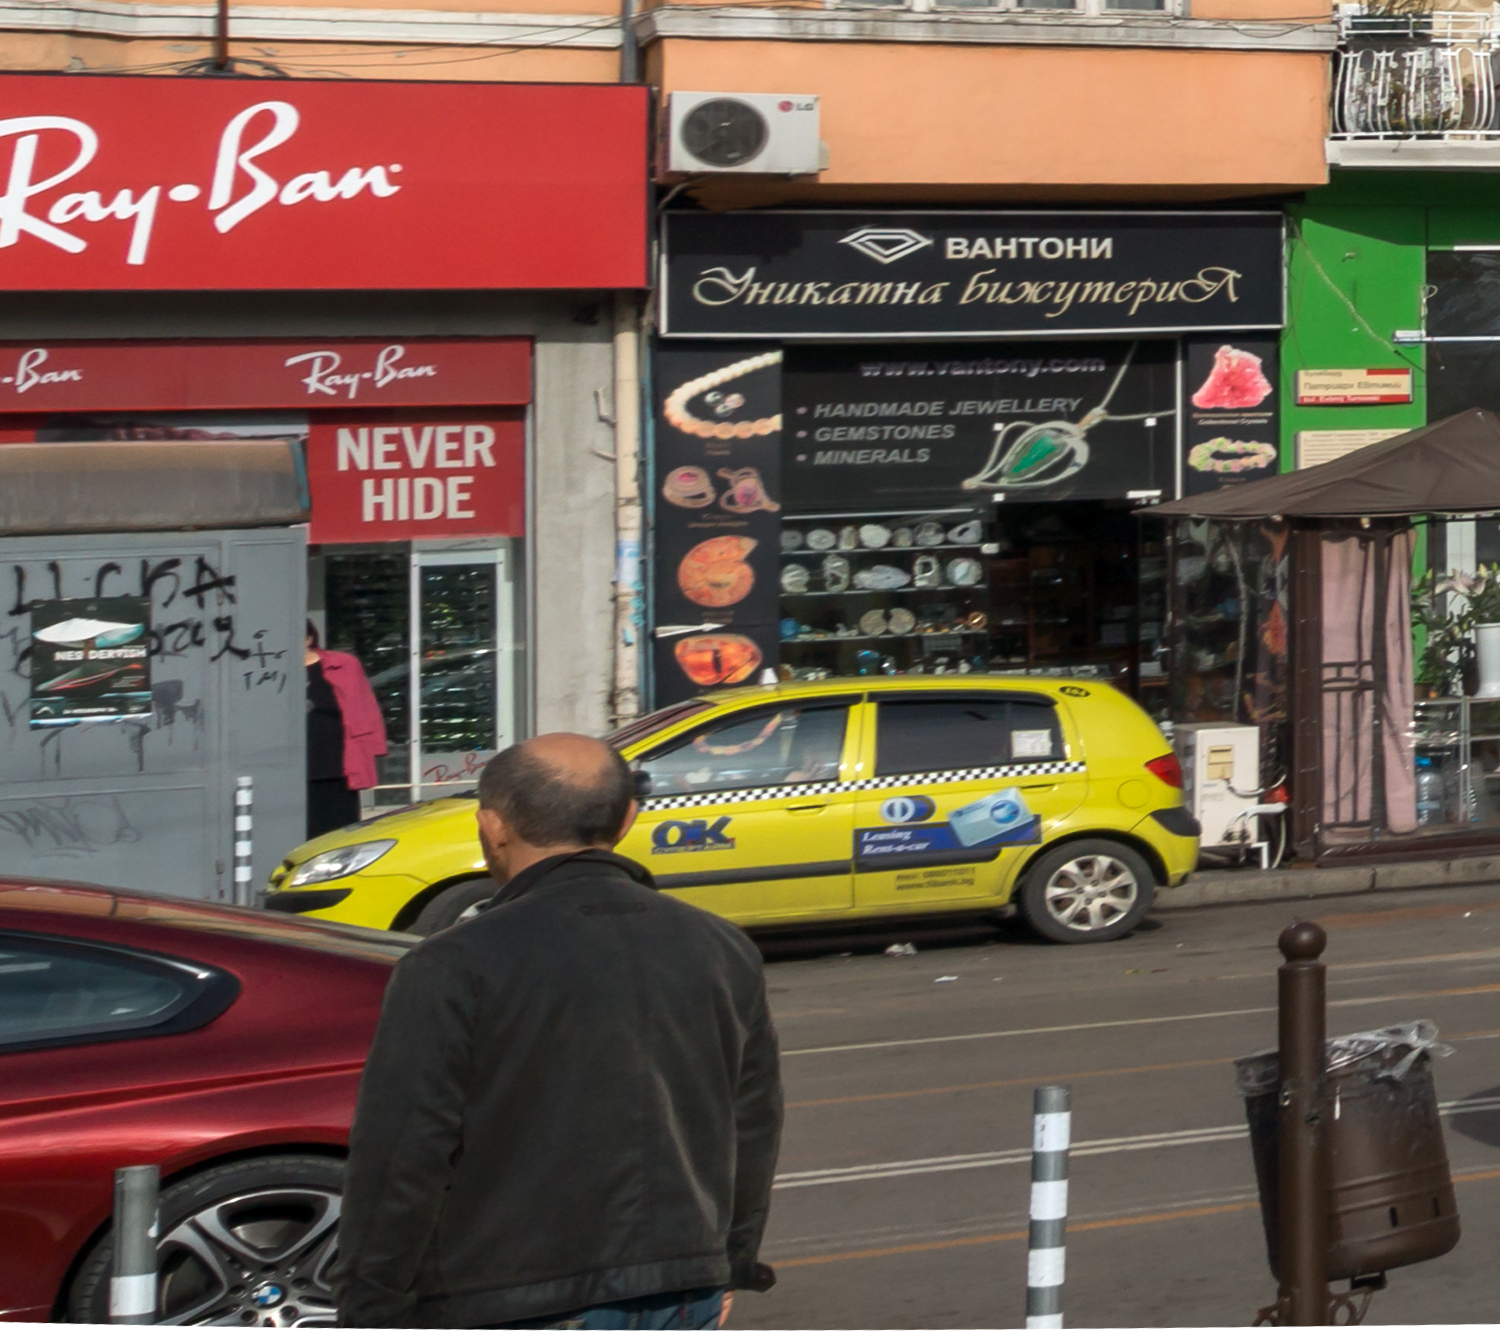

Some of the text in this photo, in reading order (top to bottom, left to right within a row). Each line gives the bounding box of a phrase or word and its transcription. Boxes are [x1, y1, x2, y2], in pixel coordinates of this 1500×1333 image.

[945, 236, 1113, 259] ВАНТОНИ
[693, 267, 949, 306] Уникатна
[285, 345, 437, 399] Ray-Ban
[814, 397, 1082, 418] HANDMADE JEWELLERY
[814, 425, 956, 441] GEMSTONES
[337, 425, 496, 472] NEVER
[814, 449, 931, 465] MINERALS
[362, 476, 475, 522] HIDE
[862, 841, 930, 855] Rent-a-car
